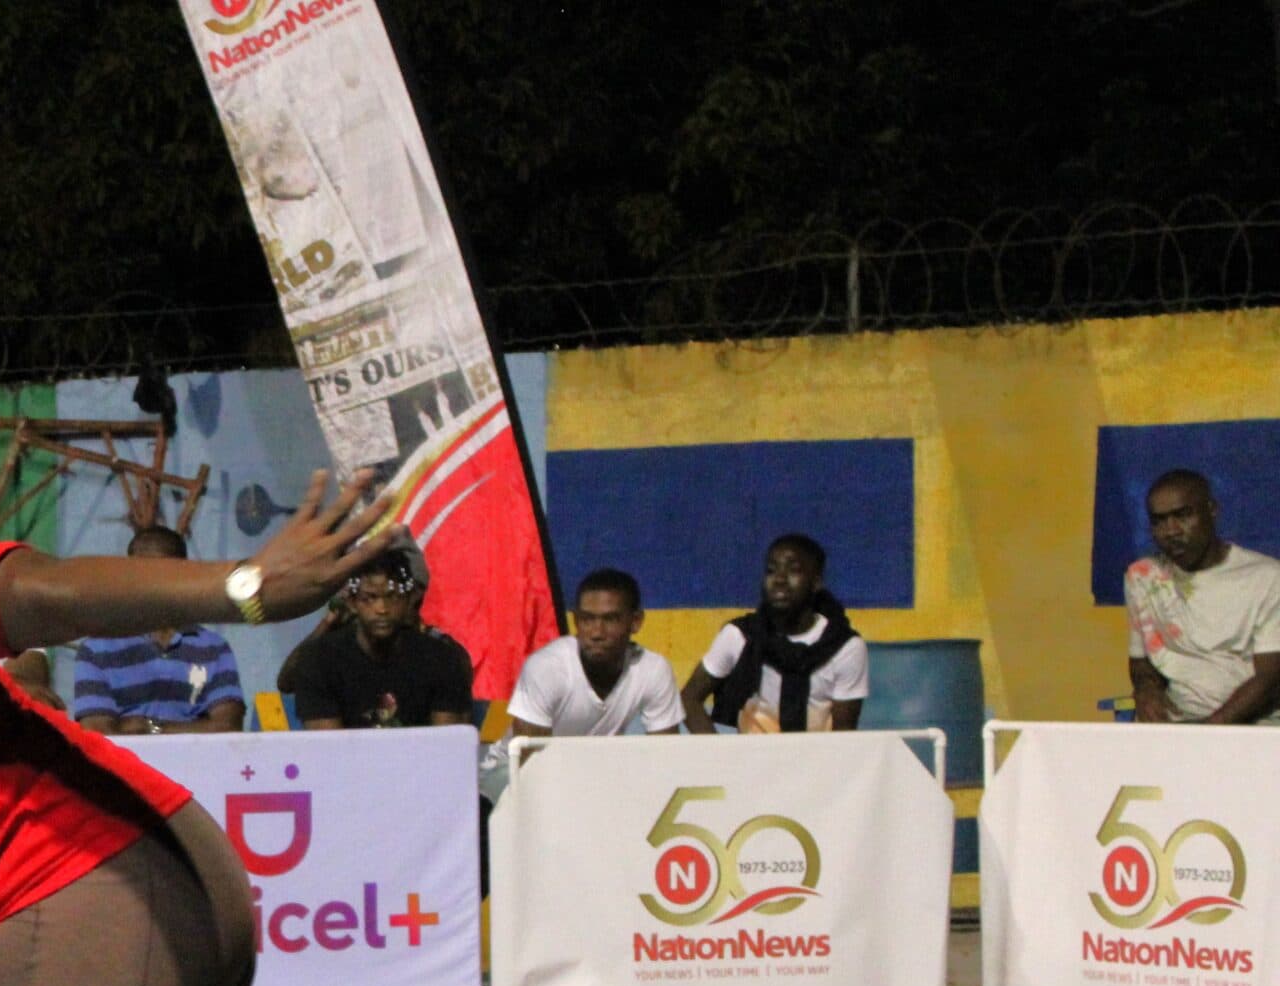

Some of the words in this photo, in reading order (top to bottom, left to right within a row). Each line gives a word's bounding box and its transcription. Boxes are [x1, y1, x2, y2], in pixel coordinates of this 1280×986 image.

[669, 860, 697, 890] N
[738, 860, 806, 874] 1973-2023
[1113, 860, 1139, 893] N
[632, 928, 832, 962] NationNews
[1081, 930, 1254, 973] NationNews
